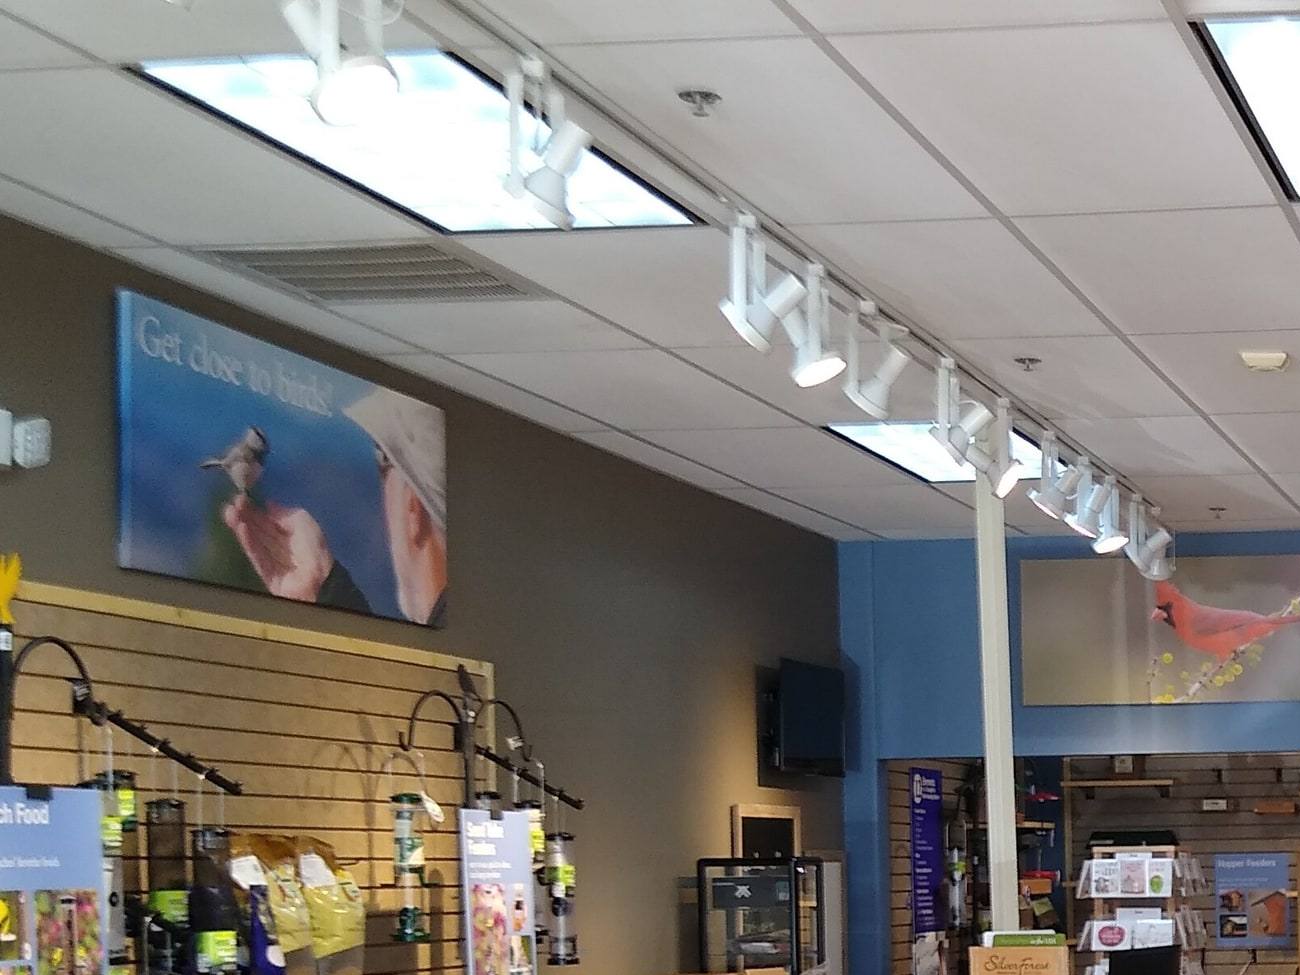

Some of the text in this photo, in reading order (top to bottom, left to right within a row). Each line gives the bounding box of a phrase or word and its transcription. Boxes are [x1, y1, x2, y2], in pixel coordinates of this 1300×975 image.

[137, 315, 184, 366] Get
[189, 332, 245, 386] close
[248, 360, 272, 397] to
